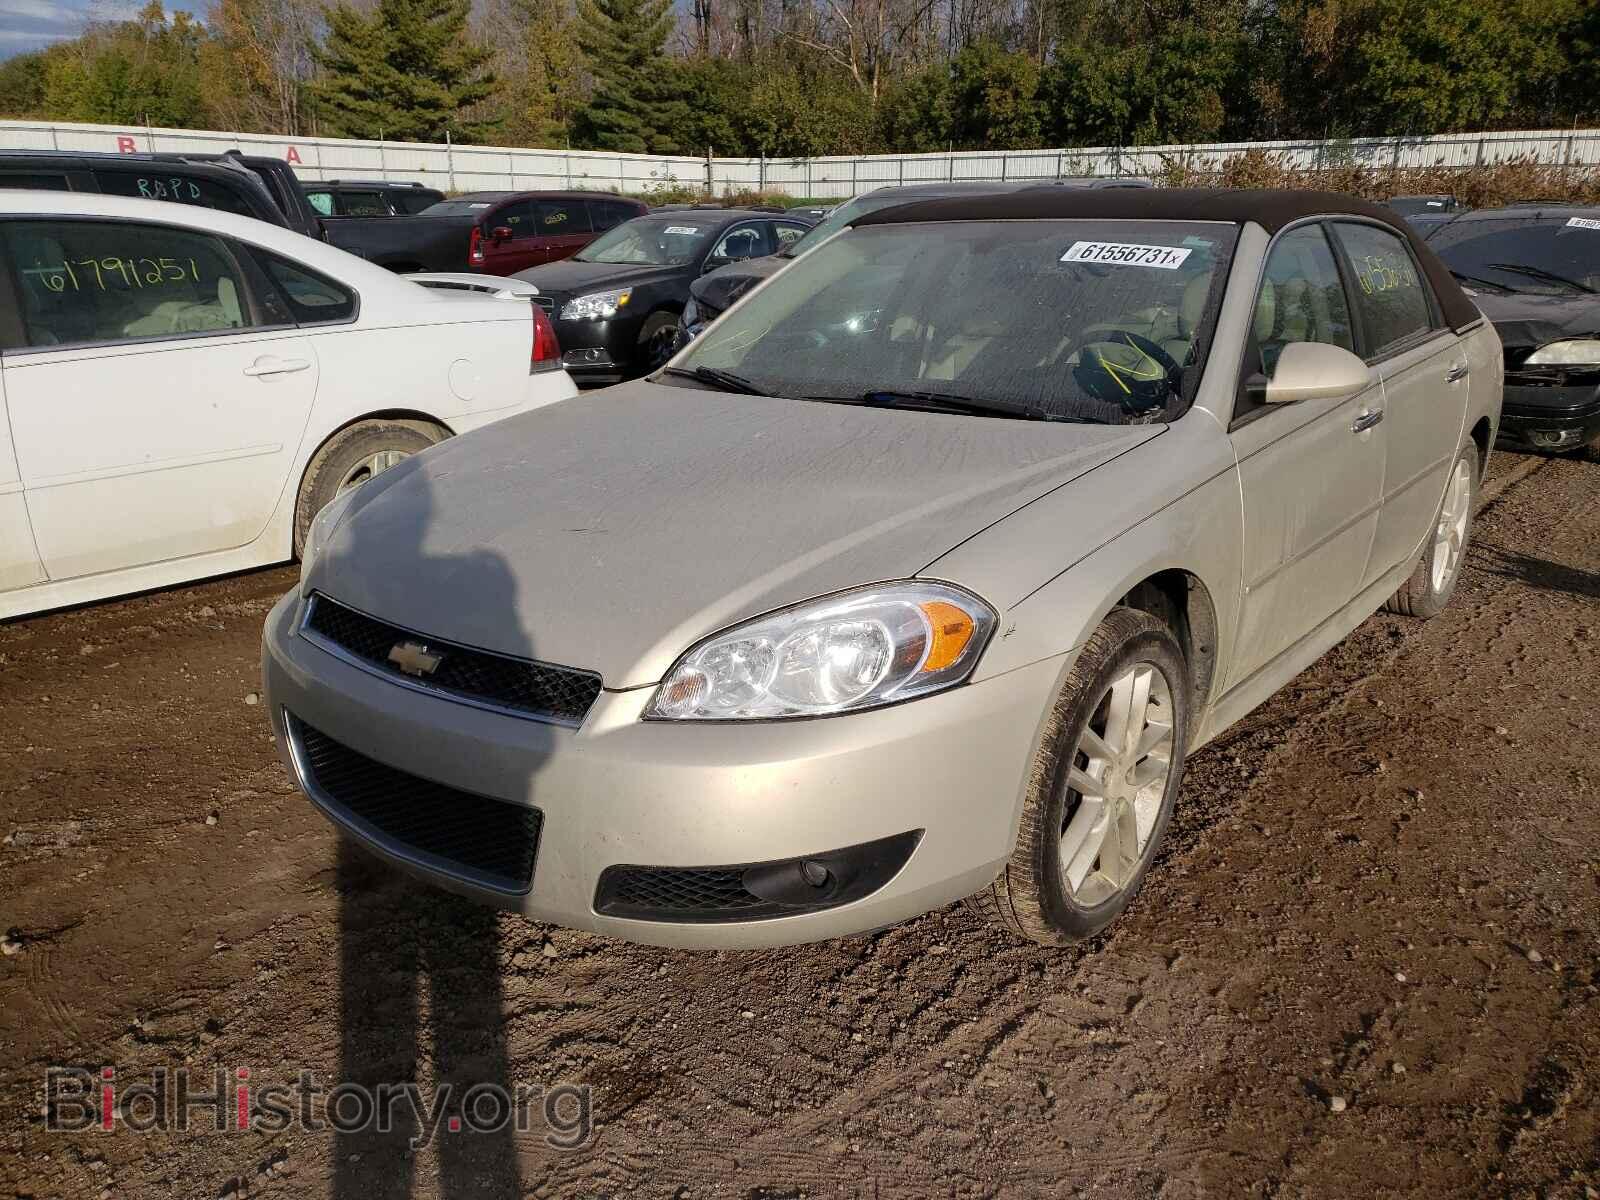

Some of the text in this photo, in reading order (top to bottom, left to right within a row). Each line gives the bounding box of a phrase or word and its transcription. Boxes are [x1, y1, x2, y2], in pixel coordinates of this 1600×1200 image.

[117, 136, 137, 154] B
[286, 146, 303, 164] A
[38, 256, 201, 292] 61791251
